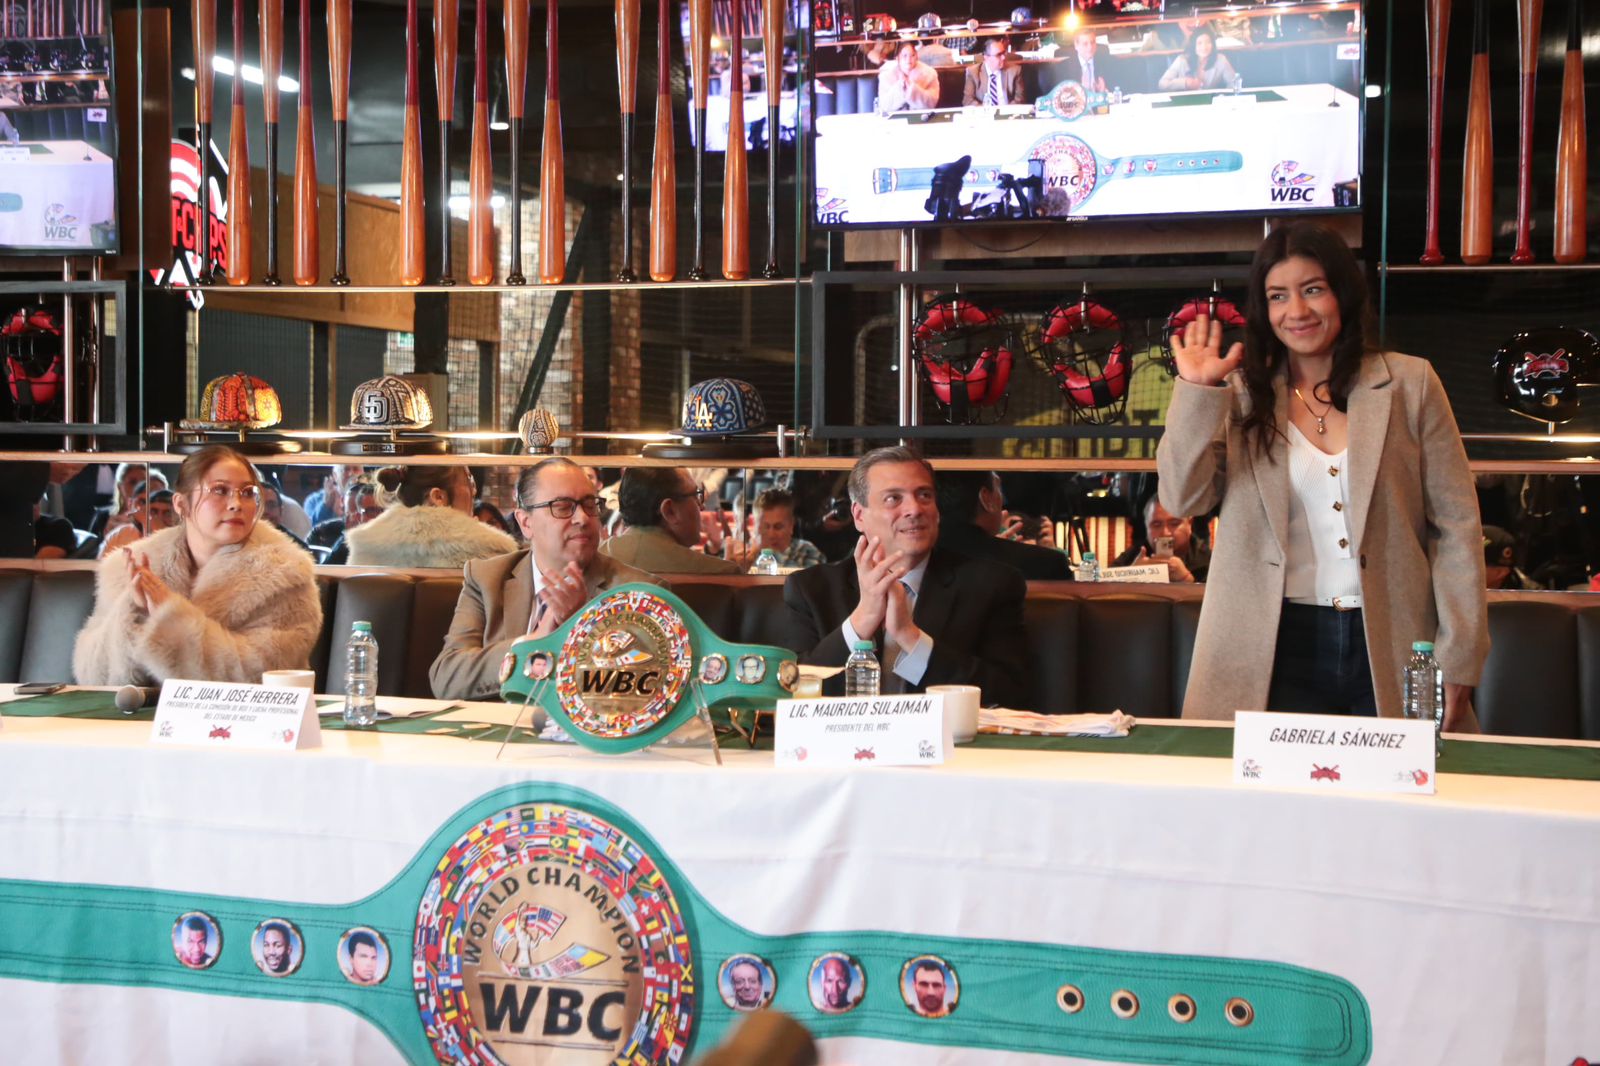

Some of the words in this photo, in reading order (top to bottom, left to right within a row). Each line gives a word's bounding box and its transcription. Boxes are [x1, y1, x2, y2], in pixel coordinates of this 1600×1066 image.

[1270, 187, 1315, 202] WBC
[44, 225, 77, 240] WBC
[694, 395, 713, 428] LA
[582, 670, 659, 694] WBC
[173, 686, 192, 699] LIC.
[194, 688, 223, 701] JUAN
[222, 686, 254, 703] JOSÉ
[250, 691, 300, 705] HERRERA
[789, 704, 808, 719] LIC.
[813, 701, 869, 718] MAURICIO
[870, 696, 933, 715] SULAIMÁN
[825, 723, 862, 733] PRESIDENTE
[863, 722, 875, 732] DEL
[1270, 727, 1336, 746] GABRIELA
[1340, 727, 1406, 749] SÁNCHEZ
[919, 751, 936, 759] WBC
[1242, 771, 1262, 779] WBC
[463, 875, 521, 966] WORLD
[526, 866, 641, 975] CHAMPION
[479, 983, 626, 1041] WBC
